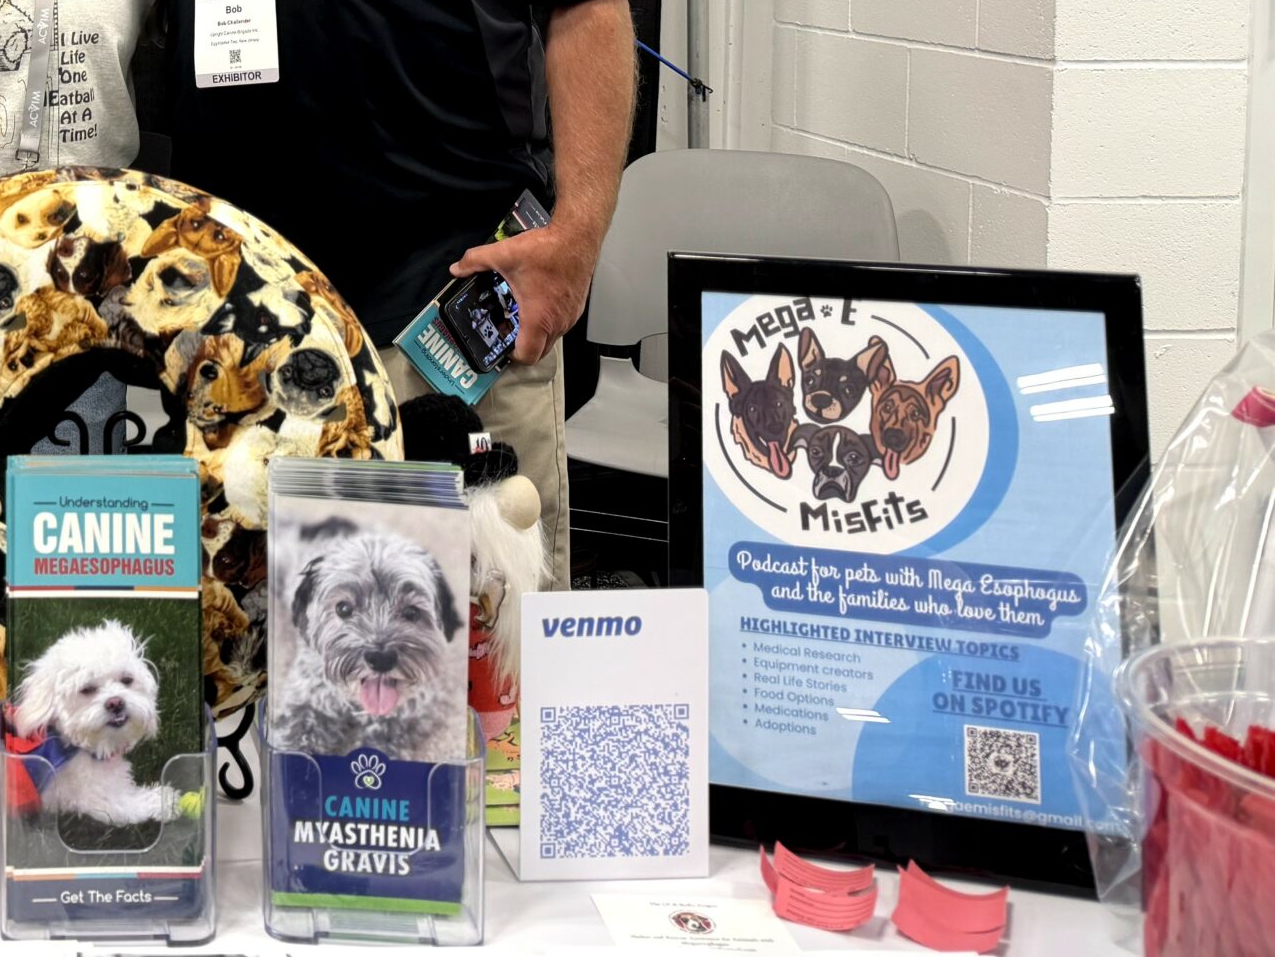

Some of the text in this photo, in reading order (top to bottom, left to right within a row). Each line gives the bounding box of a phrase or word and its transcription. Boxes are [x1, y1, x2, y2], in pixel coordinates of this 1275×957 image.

[225, 4, 243, 14] Bob
[37, 8, 51, 45] ACVIM
[71, 30, 99, 45] Live
[60, 51, 86, 65] Life
[59, 69, 87, 84] One
[212, 71, 262, 84] EXHIBITOR
[29, 90, 41, 128] ACVIM
[44, 89, 95, 107] Eatball
[60, 107, 92, 124] At A
[59, 124, 98, 143] Time!
[730, 297, 815, 357] Mega
[417, 323, 479, 389] CANINE
[59, 496, 148, 512] Understanding
[33, 511, 175, 554] CANINE
[34, 557, 175, 576] MEGAESOPHAGUS
[736, 550, 809, 577] Podcast
[810, 556, 841, 587] for
[844, 564, 881, 589] pets
[885, 566, 923, 589] with
[927, 568, 976, 602] Mega
[771, 581, 1045, 627] and the families who love them
[542, 615, 642, 638] venmo
[740, 616, 1020, 661] HIGHLIGHTED INTERVIEW TOPICS
[753, 641, 861, 664] Medical Research
[753, 657, 874, 681] Equipment creators
[753, 672, 848, 693] Real Life Stories
[953, 670, 1042, 699] FIND US
[754, 687, 834, 708] Food Options
[932, 692, 1070, 725] ON SPOTIFY
[754, 702, 829, 722] Medications
[754, 718, 817, 736] Adoptions
[325, 796, 410, 822] CANINE
[294, 821, 441, 852] MYASTHENIA
[323, 849, 411, 876] GRAVIS
[61, 889, 152, 904] Get The Facts
